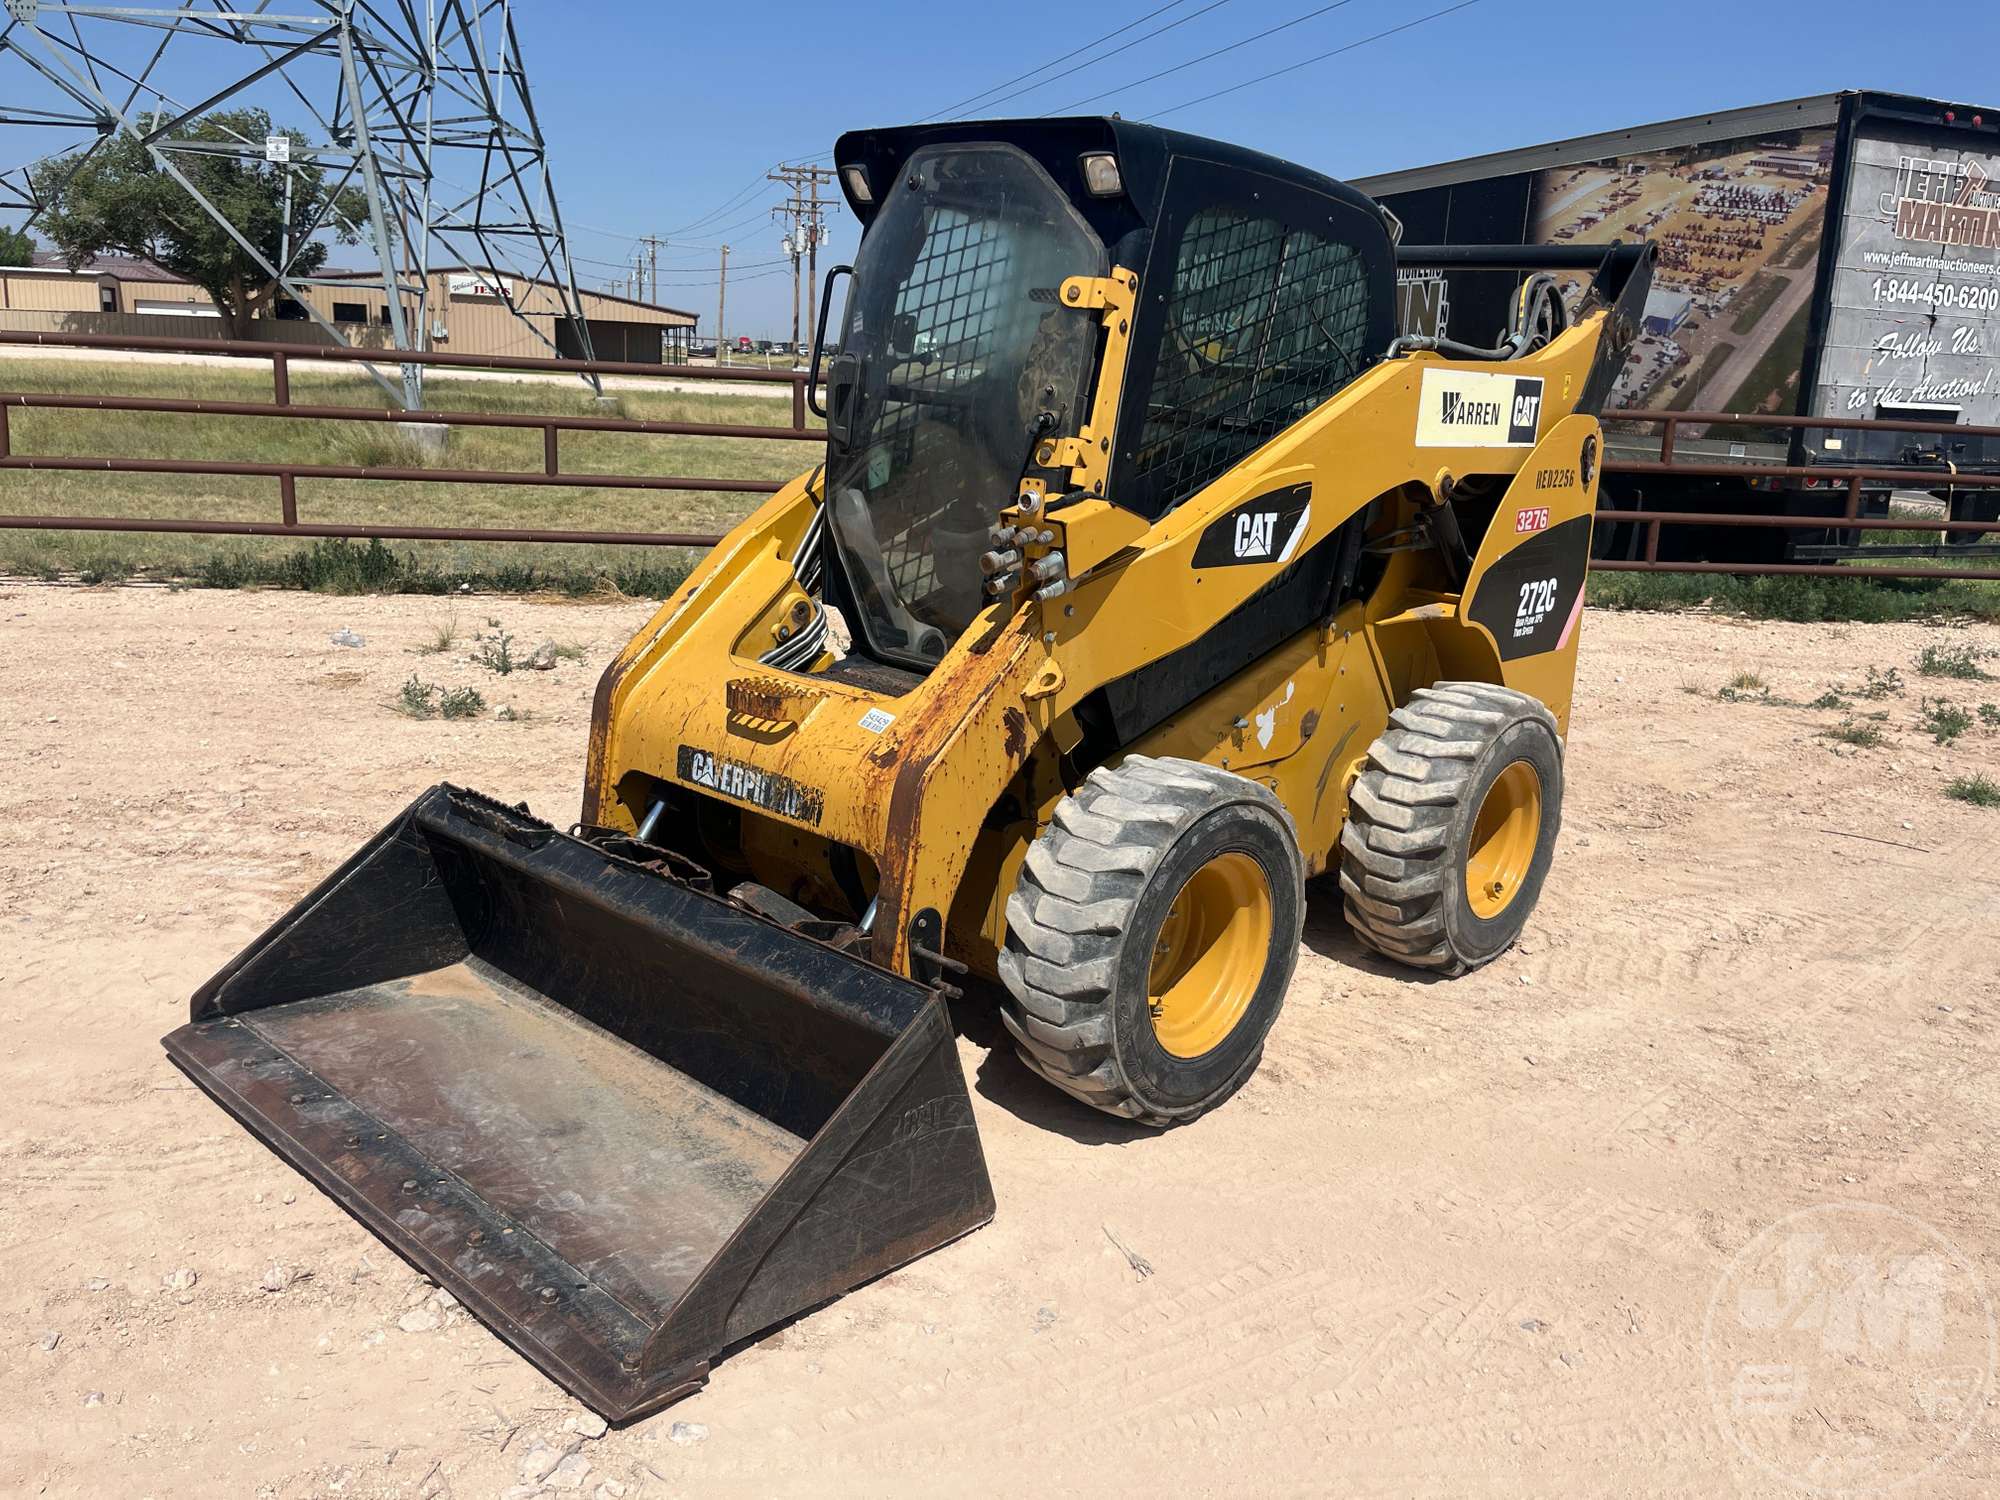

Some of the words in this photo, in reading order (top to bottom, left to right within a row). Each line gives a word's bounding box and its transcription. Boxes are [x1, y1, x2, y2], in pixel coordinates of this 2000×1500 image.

[1880, 156, 1967, 215] JEFF
[1873, 278, 1998, 311] 1-844-450-6200
[1877, 332, 1943, 366] Follow
[1952, 326, 1979, 354] Us
[1441, 391, 1501, 426] WARREN
[1513, 395, 1539, 427] CAT
[1848, 387, 1868, 410] to
[1873, 378, 1903, 407] the
[1908, 368, 1993, 403] Auction!
[1234, 512, 1278, 558] CAT
[1517, 509, 1549, 532] 3276
[1516, 577, 1558, 618] 272C
